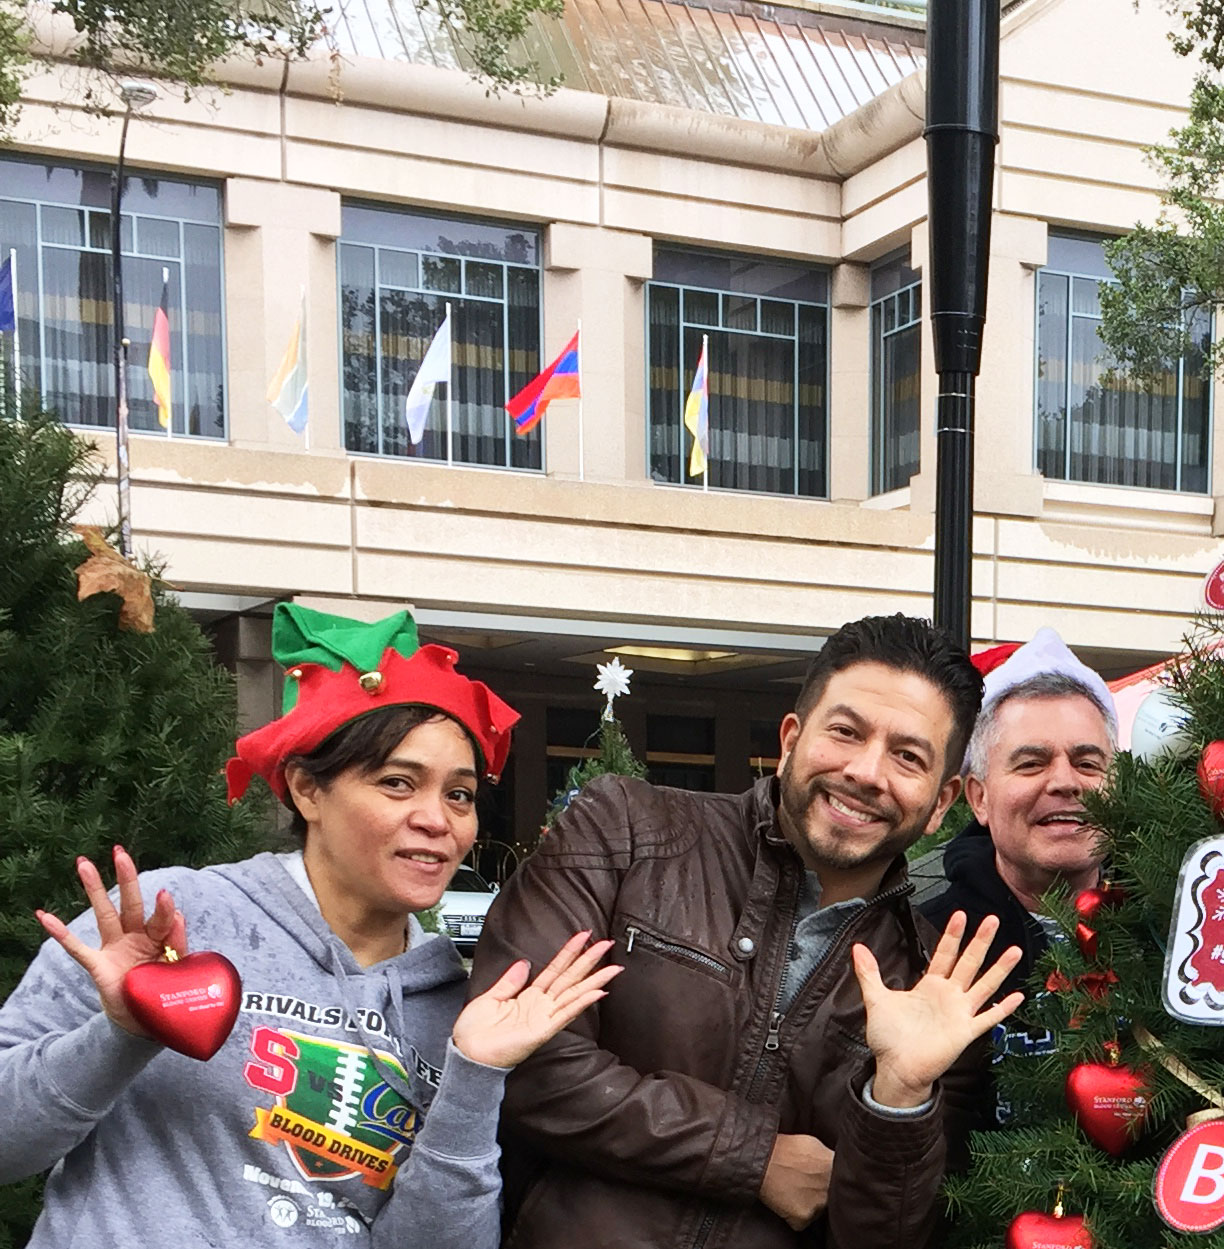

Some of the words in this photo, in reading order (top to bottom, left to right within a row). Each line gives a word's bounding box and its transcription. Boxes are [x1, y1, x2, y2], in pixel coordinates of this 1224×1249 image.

[241, 992, 342, 1027] RIVALS
[270, 1113, 327, 1148] BLOOD
[330, 1141, 390, 1174] DRIVES
